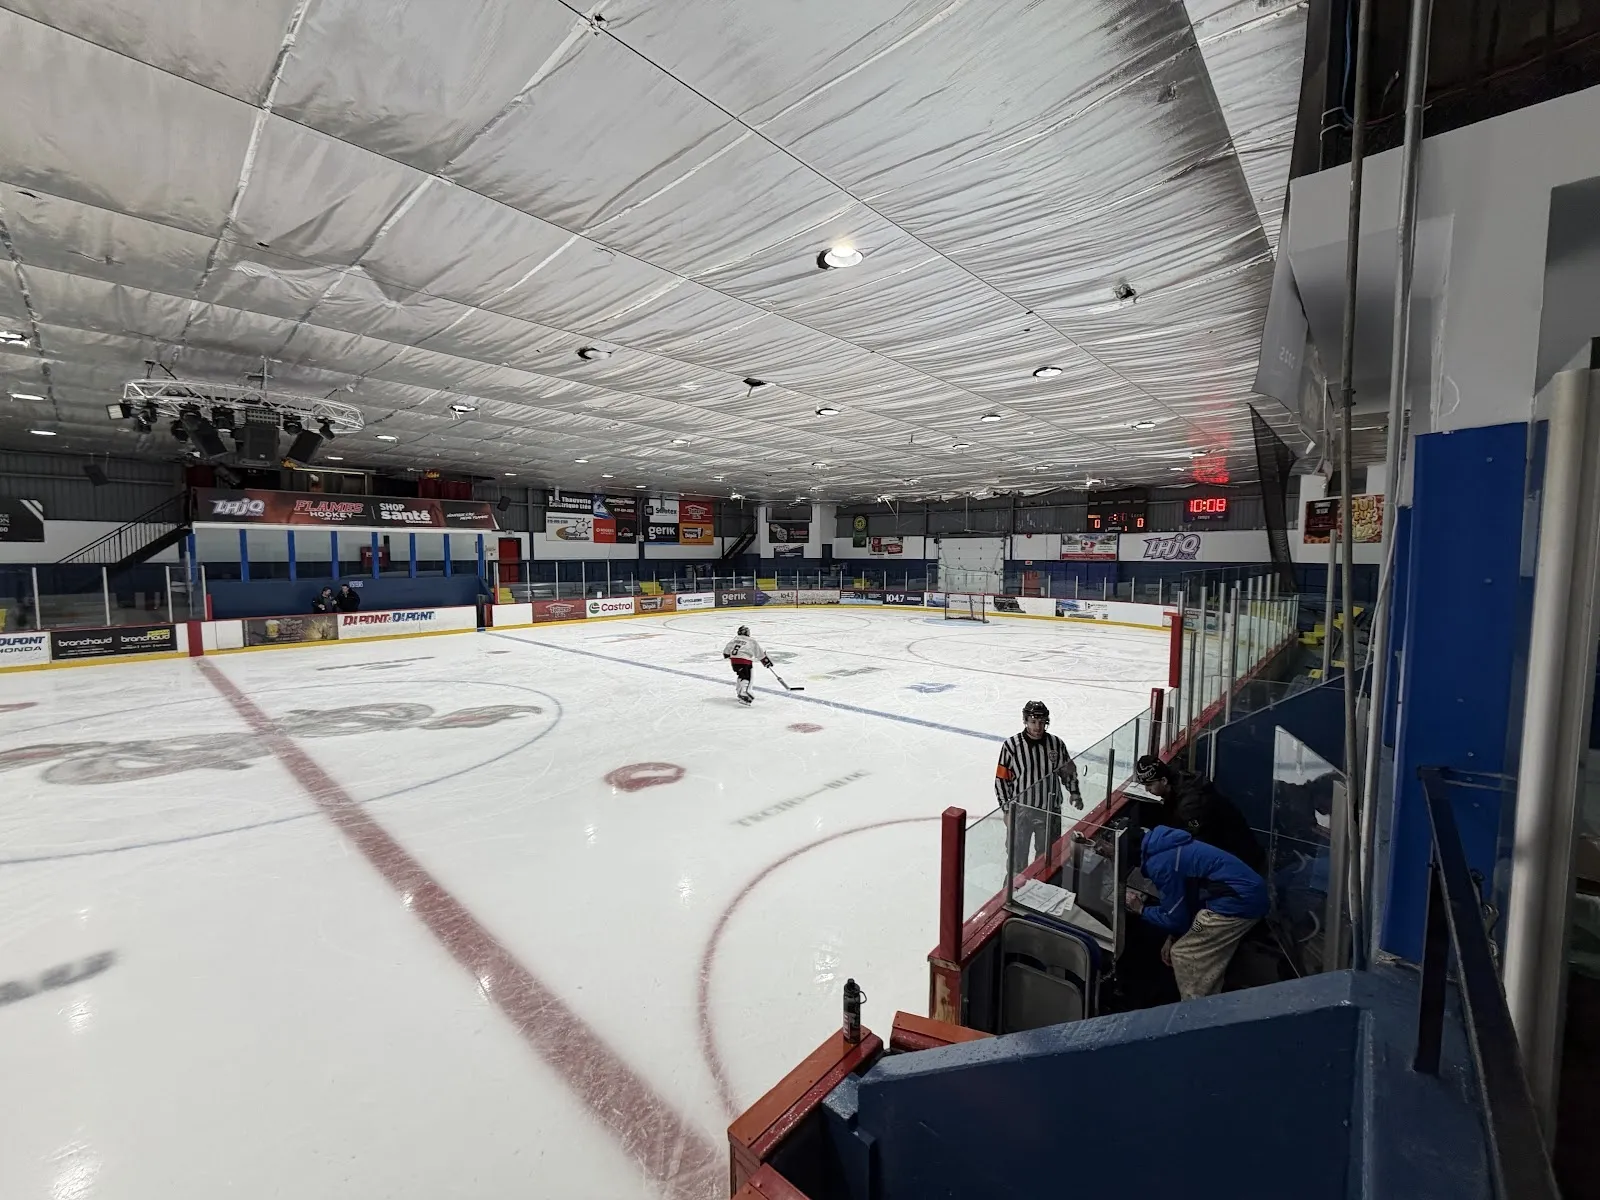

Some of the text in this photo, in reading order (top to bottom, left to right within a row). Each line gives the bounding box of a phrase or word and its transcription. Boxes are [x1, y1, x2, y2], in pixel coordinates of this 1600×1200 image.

[293, 500, 365, 513] FLAMES
[379, 502, 405, 511] SHOP
[309, 511, 353, 519] HOCKEY
[380, 509, 431, 521] santé
[886, 594, 905, 602] 104.7
[601, 602, 633, 612] Castrol
[58, 636, 113, 648] branchaud
[120, 633, 171, 643] branchaud
